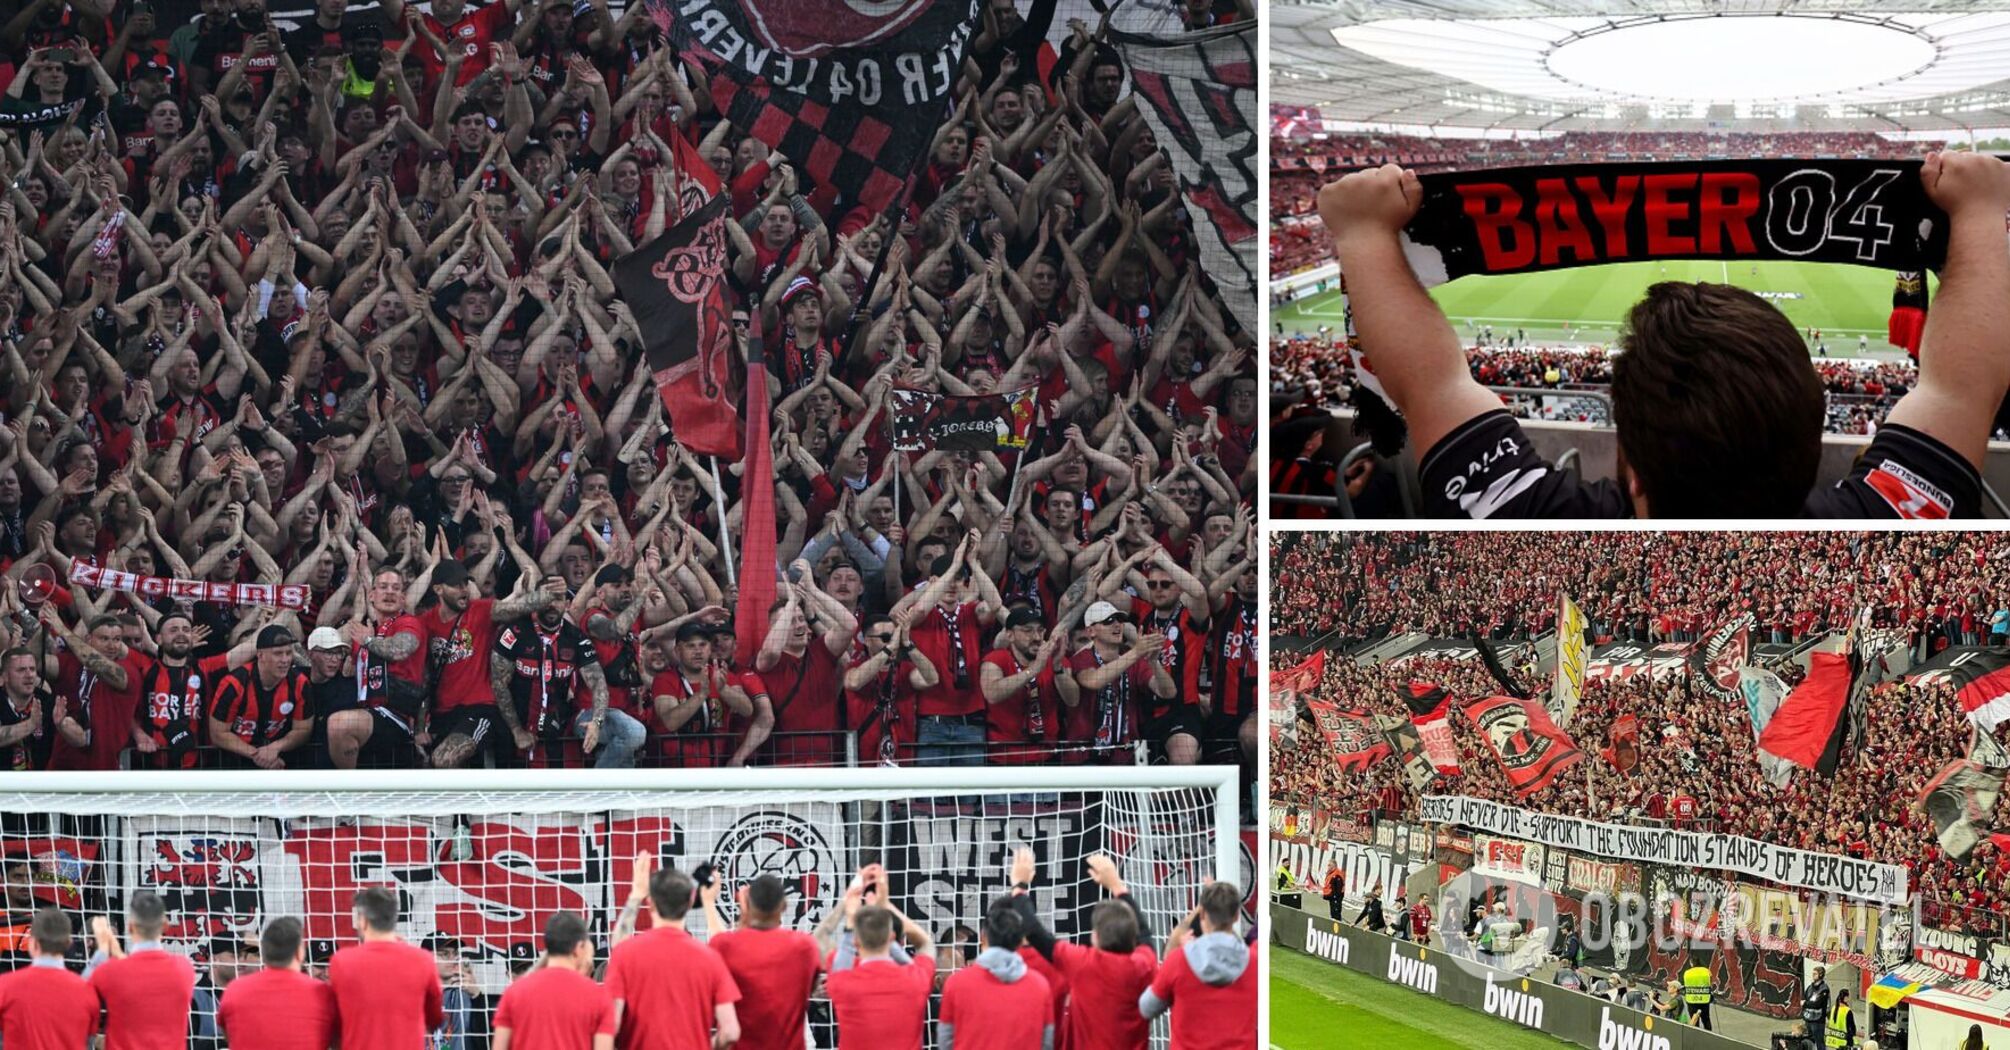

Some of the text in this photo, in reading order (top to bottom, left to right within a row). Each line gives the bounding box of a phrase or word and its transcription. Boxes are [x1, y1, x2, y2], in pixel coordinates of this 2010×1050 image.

[1455, 168, 1902, 271] BAYER 04
[1444, 437, 1520, 501] trive
[1883, 462, 1953, 509] BUNDESLIGA
[71, 561, 303, 607] KICKERS
[913, 815, 1072, 879] WEST
[1421, 798, 1454, 821] HEROES
[1460, 798, 1498, 827] NEVER
[1502, 808, 1521, 833] DIE
[1530, 814, 1582, 846] SUPPORT
[1586, 823, 1615, 856] THE
[1618, 828, 1700, 865] FOUNDATION
[1705, 834, 1768, 872] STANDS
[1775, 849, 1796, 881] OF
[1801, 853, 1878, 896] HEROES
[1305, 917, 1350, 965] bwin
[1387, 941, 1438, 994] bwin
[1919, 926, 1977, 959] YOUNG
[1921, 949, 1968, 976] BOYS
[1483, 971, 1544, 1029] bwin
